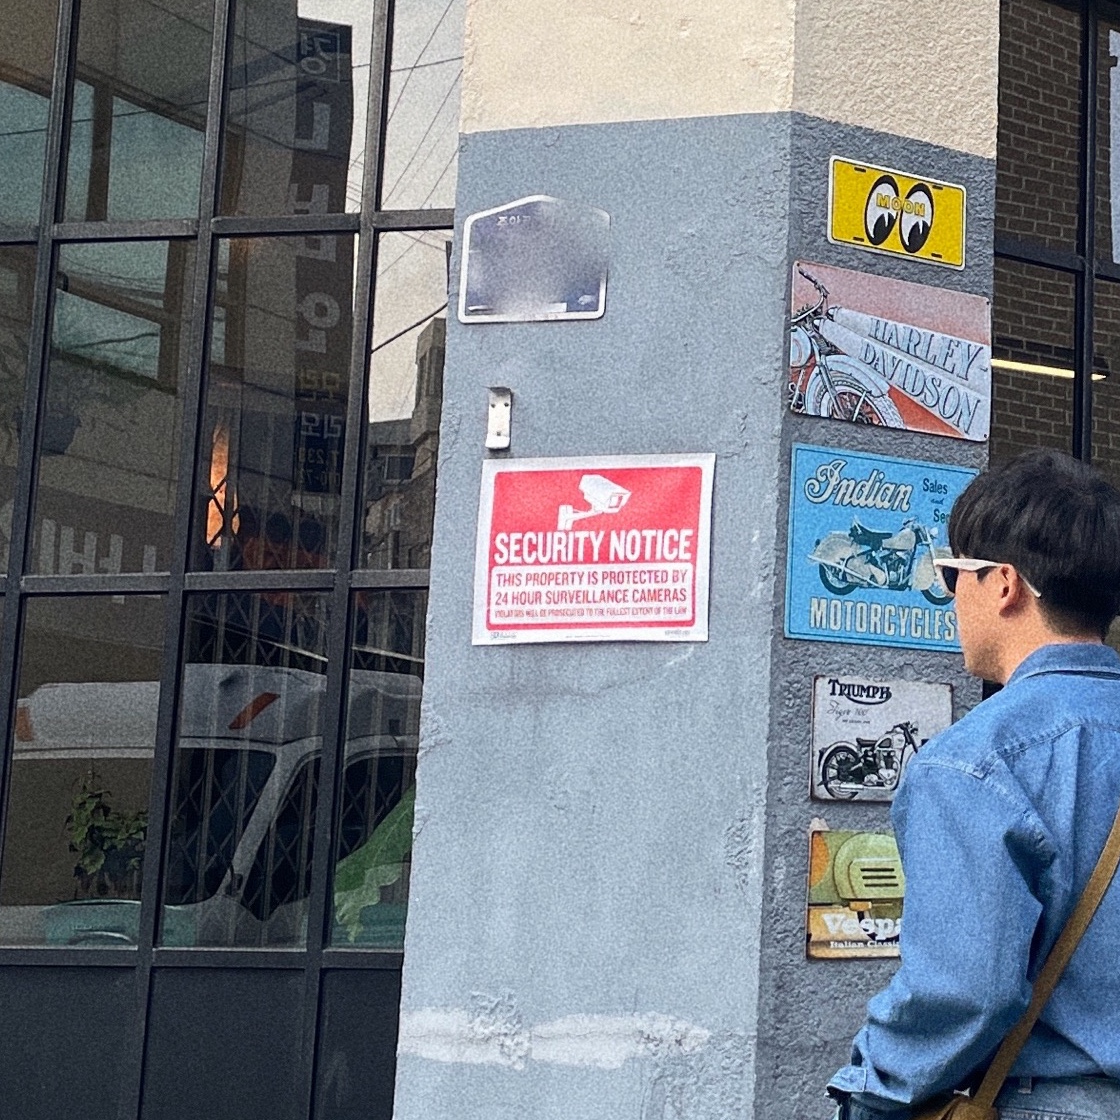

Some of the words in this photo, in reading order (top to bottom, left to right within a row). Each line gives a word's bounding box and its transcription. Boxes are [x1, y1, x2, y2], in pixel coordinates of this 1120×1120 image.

[876, 193, 926, 217] MOON
[859, 341, 980, 435] DAVIDSON
[804, 459, 914, 512] Indian
[922, 477, 948, 495] Sales
[494, 530, 605, 565] SECURITY
[609, 528, 693, 562] NOTICE
[496, 572, 522, 587] THIS
[525, 570, 584, 587] PROPERTY
[587, 571, 599, 586] IS
[602, 569, 668, 585] PROTECTED
[672, 568, 688, 583] BY
[495, 591, 508, 606] 24
[511, 590, 542, 605] HOUR
[545, 589, 629, 605] SURVEILLANCE
[632, 587, 687, 603] CAMERAS
[606, 606, 630, 617] FULLEST
[810, 597, 956, 641] MOTORCYCLES
[828, 678, 892, 705] TRIUMPH
[830, 941, 864, 949] Italian
